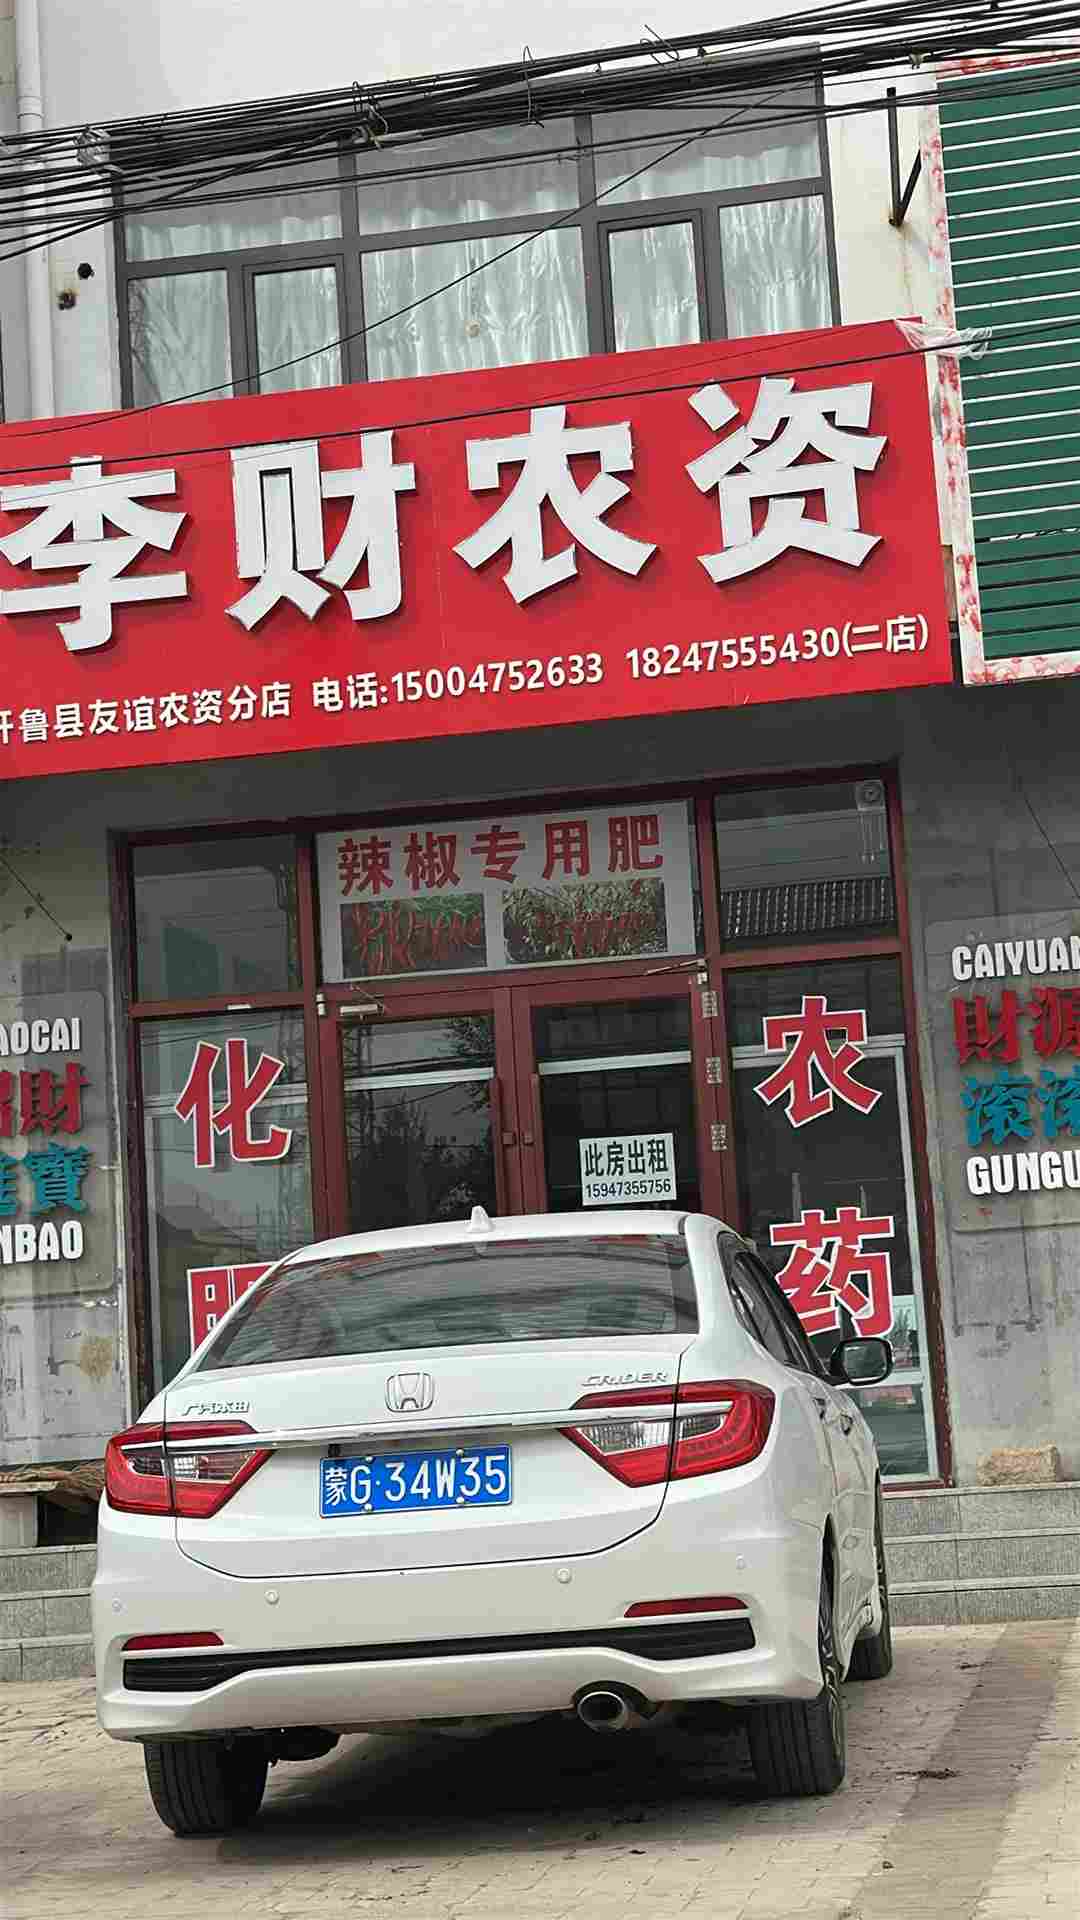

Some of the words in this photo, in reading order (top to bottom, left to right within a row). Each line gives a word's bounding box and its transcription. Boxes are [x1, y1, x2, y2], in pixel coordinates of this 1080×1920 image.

[0, 376, 888, 651] 李财农资
[337, 814, 664, 896] 辣椒专用肥
[585, 1139, 669, 1176] 此房出租
[585, 1178, 671, 1198] 15947355756
[324, 1454, 507, 1506] 蒙G·34W35
